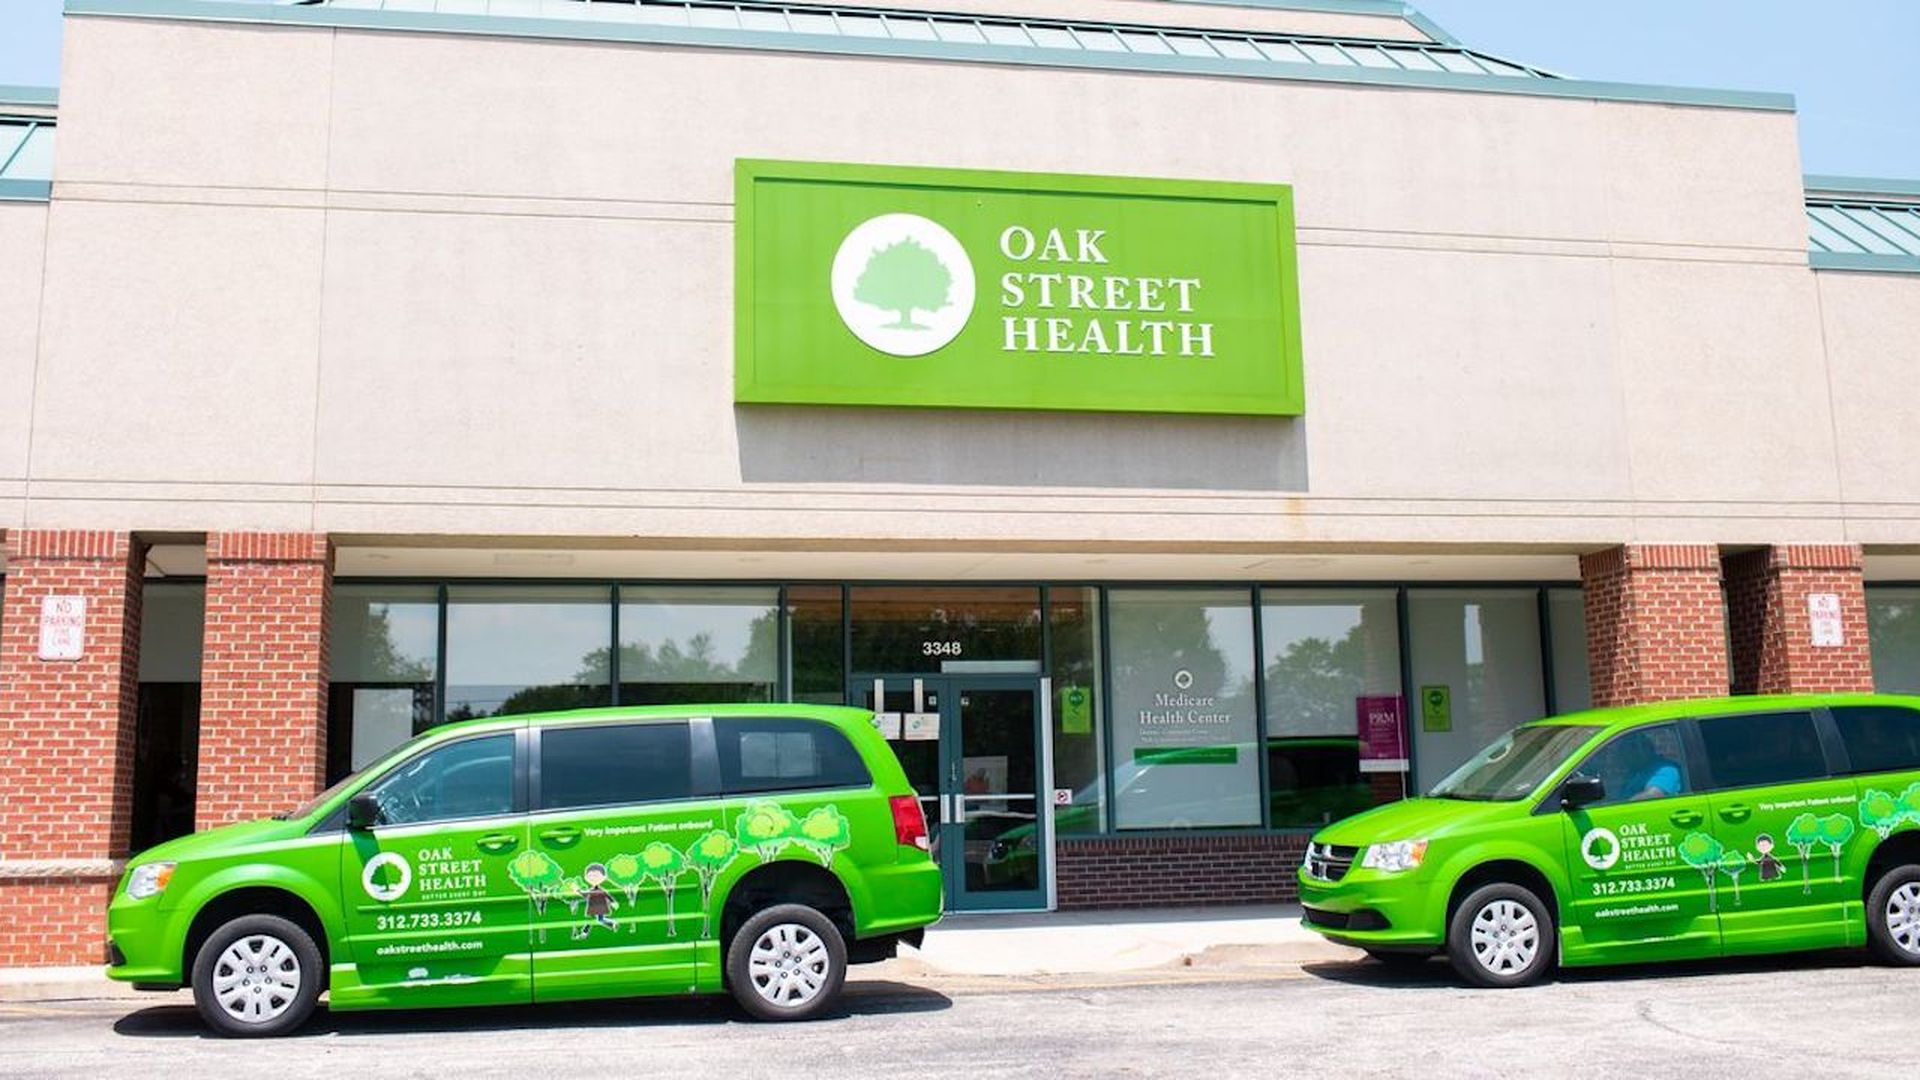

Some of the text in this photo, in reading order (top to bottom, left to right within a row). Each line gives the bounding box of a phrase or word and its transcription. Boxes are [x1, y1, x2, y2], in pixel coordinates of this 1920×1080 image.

[1000, 226, 1109, 265] OAK
[1001, 273, 1201, 313] STREET
[1001, 317, 1215, 357] HEALTH
[922, 641, 962, 656] 3348
[1155, 693, 1215, 707] Medicare
[1140, 710, 1230, 724] Health Center
[584, 826, 604, 837] Very
[604, 824, 647, 836] Important
[647, 823, 677, 832] Patient
[1619, 823, 1647, 836] OAK
[1621, 833, 1671, 849] STREET
[418, 847, 453, 862] OAK
[1623, 846, 1676, 862] HEALTH
[418, 860, 482, 876] STREET
[419, 874, 487, 892] HEALTH
[1592, 877, 1675, 896] 312.733.3374
[376, 911, 482, 931] 312.733.3374
[376, 941, 483, 956] oakstreethealth.com
